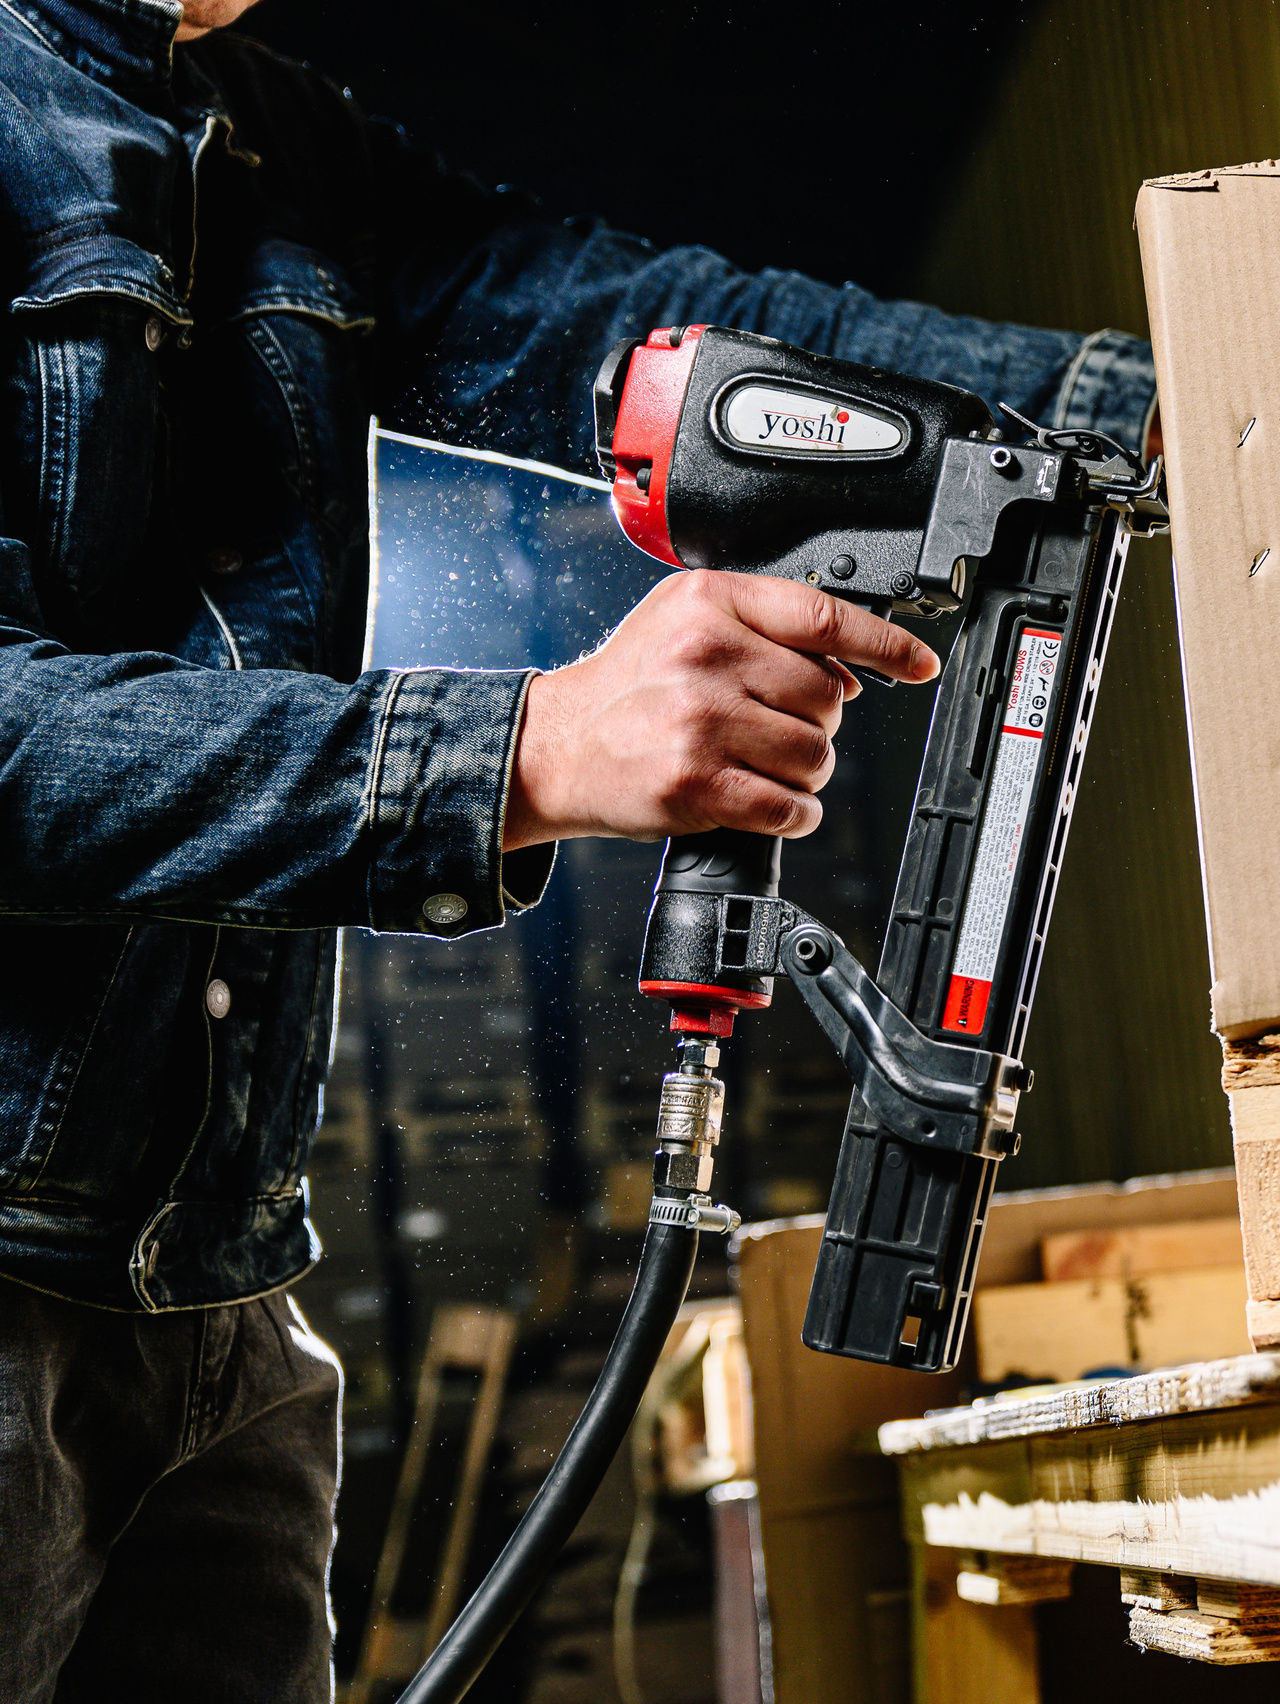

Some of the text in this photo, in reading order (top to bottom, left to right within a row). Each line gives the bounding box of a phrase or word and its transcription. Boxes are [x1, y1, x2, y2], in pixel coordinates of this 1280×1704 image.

[758, 411, 850, 444] yoshi
[1008, 649, 1027, 710] Yoshi S40WS
[960, 980, 974, 1016] WARNING
